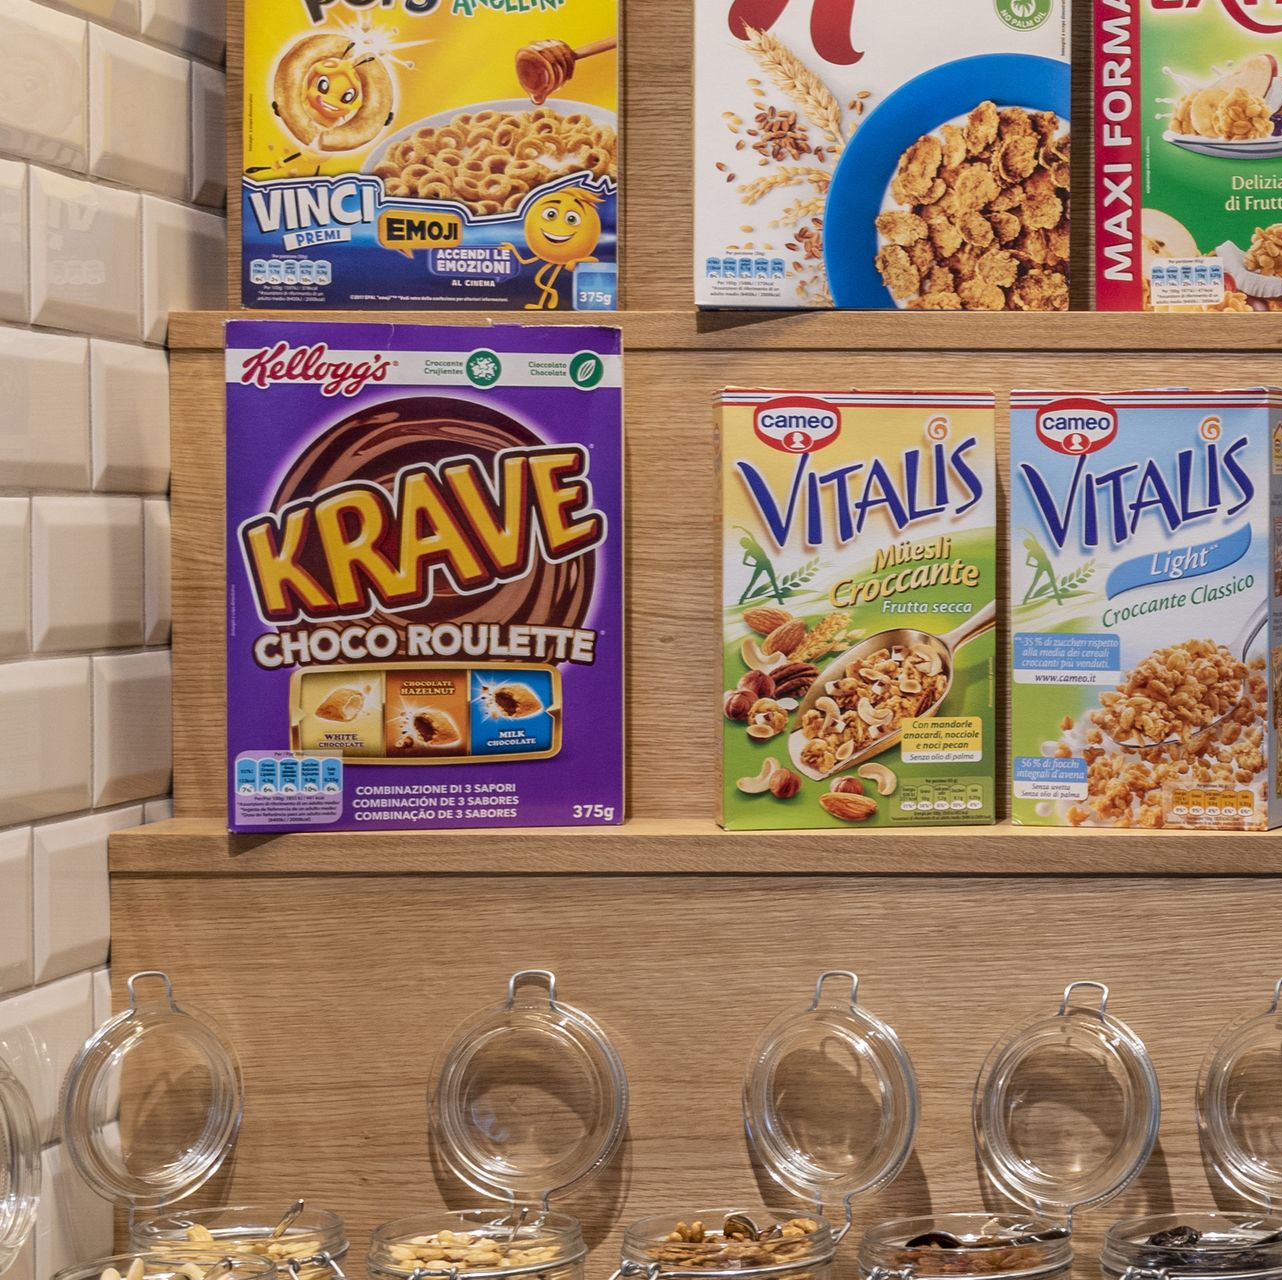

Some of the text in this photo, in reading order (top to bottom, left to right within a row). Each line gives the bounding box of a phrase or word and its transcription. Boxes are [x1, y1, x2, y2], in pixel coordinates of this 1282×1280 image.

[249, 184, 376, 232] VINCI
[1224, 196, 1242, 212] di
[1102, 163, 1134, 282] MAXI
[386, 218, 459, 242] EMOJI
[295, 229, 342, 246] PREMI
[436, 248, 511, 261] ACCENDI LE
[436, 261, 511, 274] EMOZIONI
[451, 278, 496, 288] AL CINEMA
[578, 291, 612, 305] 375g
[242, 342, 392, 395] Kellogg's
[424, 359, 464, 367] Croccante
[424, 367, 464, 376] Crujientes
[760, 413, 834, 430] cameo
[1042, 415, 1111, 432] cameo
[737, 417, 984, 547] VITALIS
[1020, 417, 1255, 548] VITALIS
[247, 453, 597, 615] KRAVE
[872, 535, 951, 573] Müesli
[829, 560, 980, 609] Croccante
[881, 600, 972, 614] Frutta secca
[1102, 574, 1255, 628] Croccante Classico
[254, 626, 596, 667] CHOCO ROULETTE
[1035, 673, 1097, 683] www.cameo.it
[400, 687, 455, 696] HAZELNUT
[912, 720, 973, 729] Con mandorle
[324, 733, 358, 741] WHITE
[498, 730, 525, 739] MILK
[903, 730, 980, 740] anacardi, nocciole
[486, 738, 536, 747] CHOCOLATE
[922, 742, 969, 751] noci pecan
[909, 753, 931, 761] Senza
[952, 752, 974, 761] palma
[355, 783, 517, 796] COMBINAZIONE DI 3 SAPORI
[352, 794, 520, 809] COMBINACIÓN DE 3 SABORES
[354, 808, 518, 822] COMBINAÇÃO DE 3 SABORES
[572, 804, 615, 821] 375g
